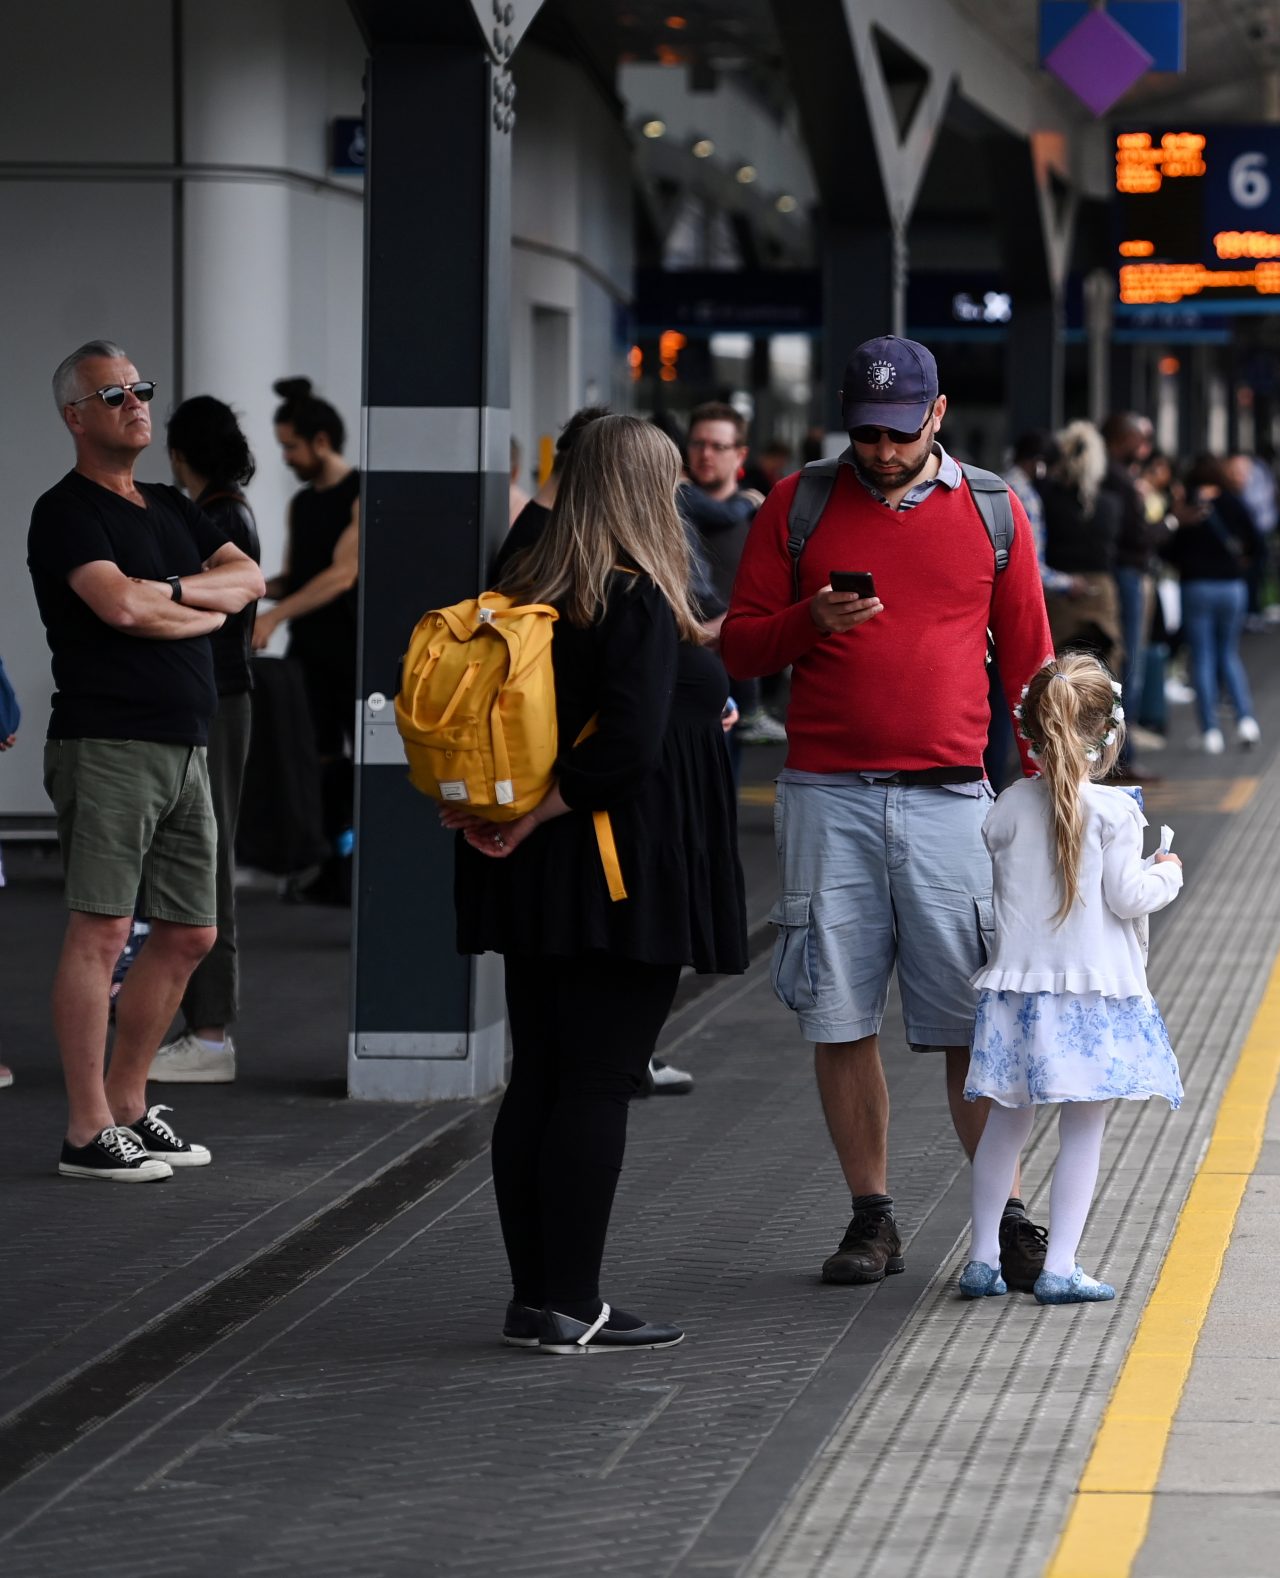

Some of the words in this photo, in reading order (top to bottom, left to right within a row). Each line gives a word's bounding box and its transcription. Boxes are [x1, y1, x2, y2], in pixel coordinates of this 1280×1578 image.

[1229, 153, 1271, 208] 6
[867, 360, 896, 376] PEMBROKE
[868, 380, 893, 390] CASTLE
